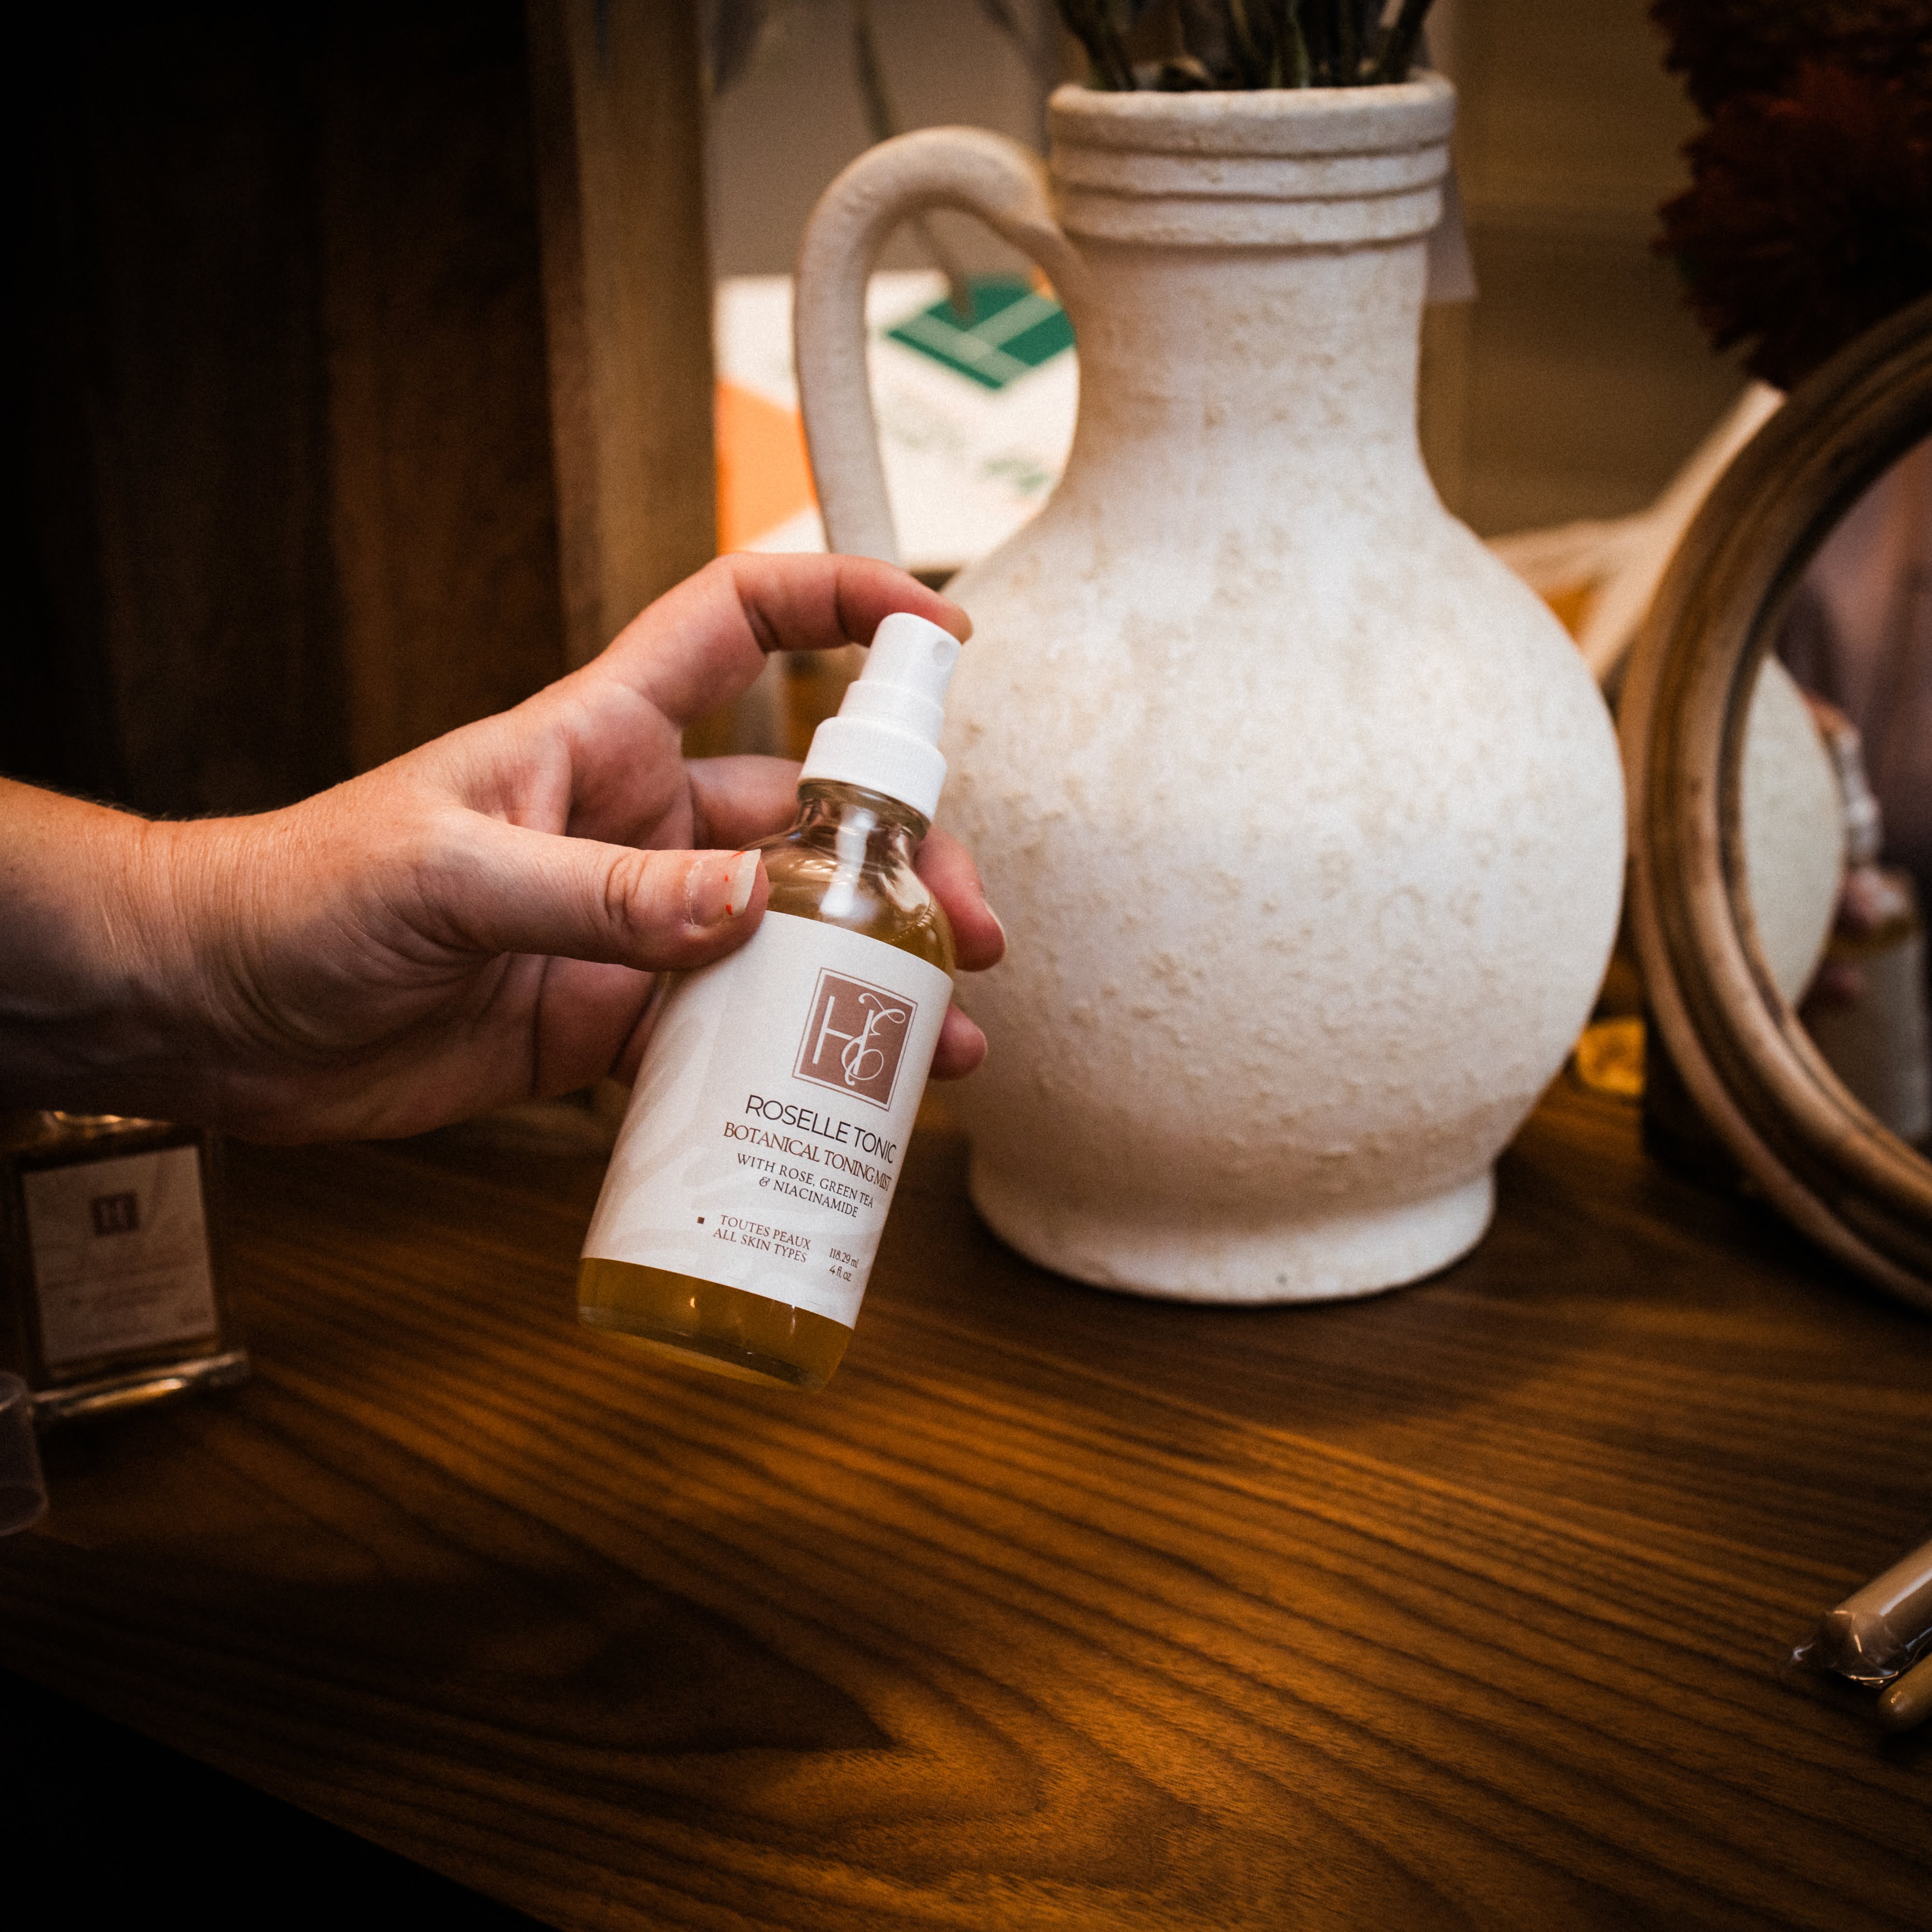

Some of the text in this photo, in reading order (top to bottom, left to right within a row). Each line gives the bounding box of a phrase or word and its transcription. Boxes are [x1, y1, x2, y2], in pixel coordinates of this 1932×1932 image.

[745, 1094, 897, 1163] ROSELLE TONIC
[723, 1122, 892, 1191] BOTANICAL TONING MIST
[737, 1153, 873, 1208] WITH ROSE, GREEN TEA
[759, 1176, 859, 1217] & NIACINAMIDE
[713, 1228, 807, 1263] ALL SKIN TYPES
[720, 1215, 812, 1250] TOUTES PEAUX
[829, 1248, 859, 1268] 118.29 ml
[830, 1265, 835, 1274] 4
[843, 1271, 851, 1282] oz
